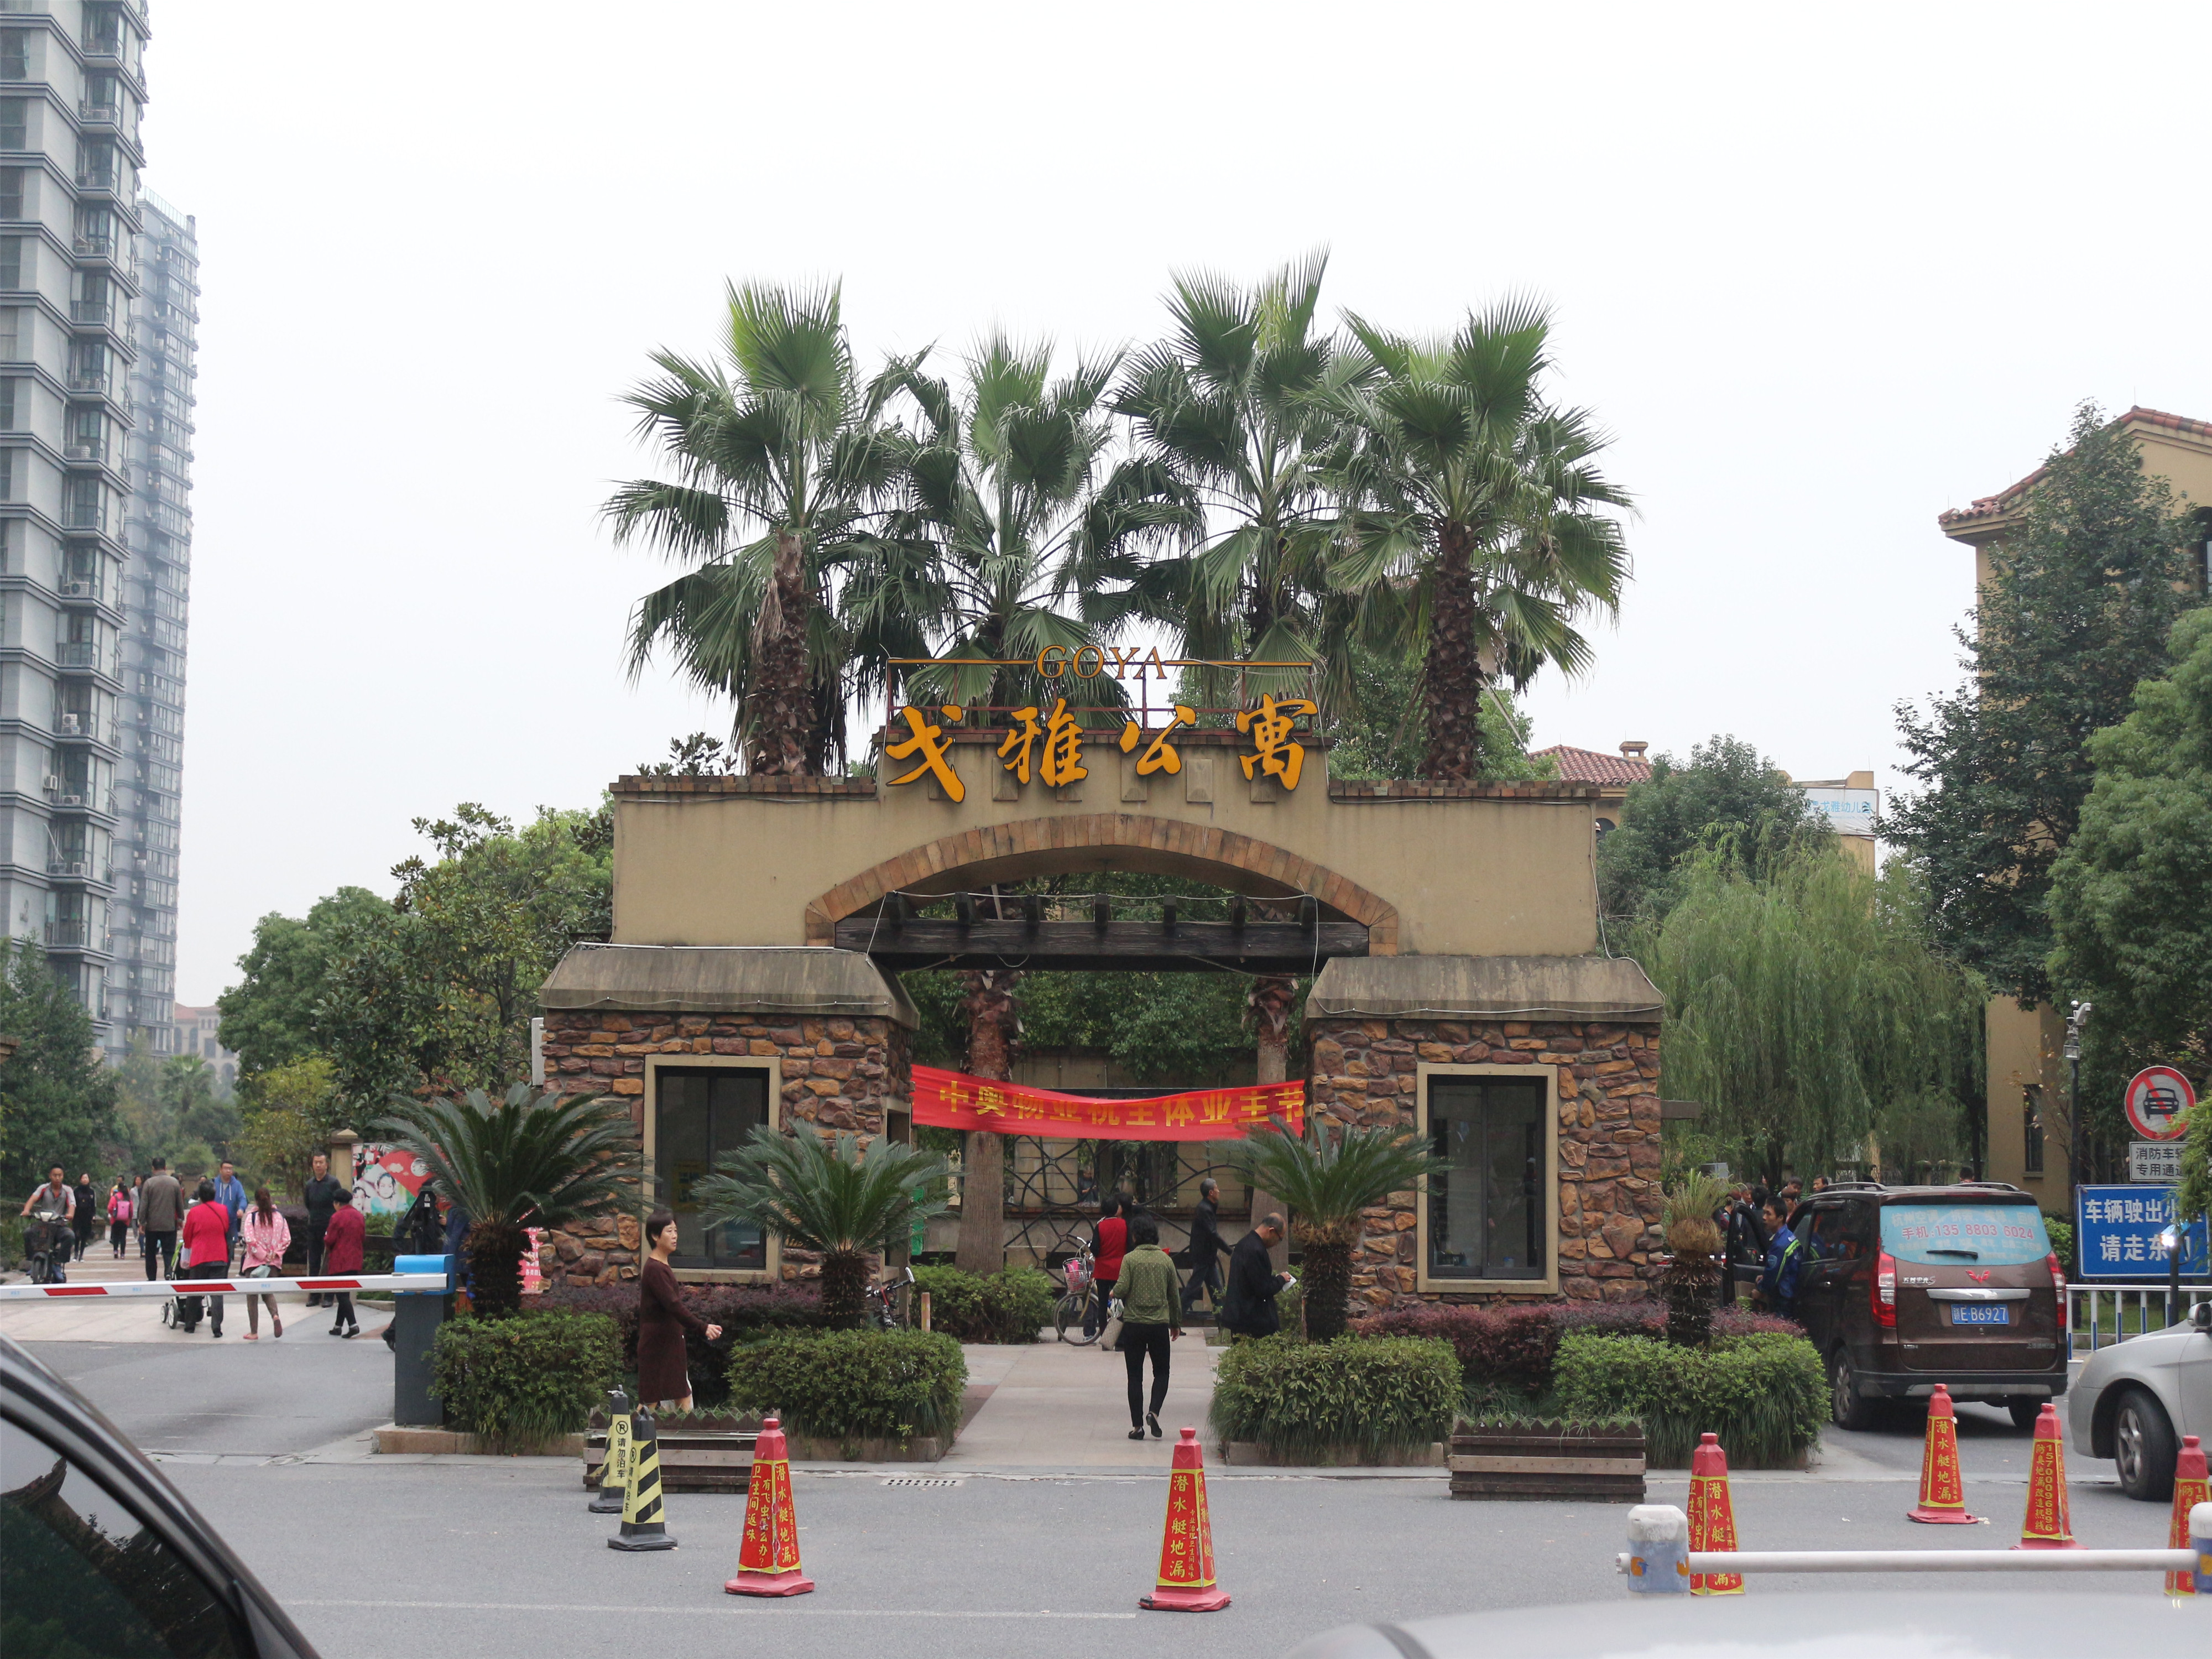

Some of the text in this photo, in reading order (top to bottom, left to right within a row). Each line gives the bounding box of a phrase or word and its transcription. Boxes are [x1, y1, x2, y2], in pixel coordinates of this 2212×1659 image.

[1037, 645, 1167, 681] GOYA
[885, 693, 1318, 803] 戈雅公寓
[1965, 1224, 1997, 1237] 8803
[2004, 1225, 2034, 1240] 6024
[2085, 1199, 2203, 1224] 车辆驶出小
[617, 1438, 626, 1479] 请勿泊车
[1936, 1421, 1951, 1501] 潜水艇地漏
[2036, 1444, 2045, 1530] 防臭地漏改造热线
[2045, 1444, 2053, 1531] 15700096896
[747, 1465, 761, 1542] 卫生间返味
[776, 1465, 791, 1563] 潜水艇地漏
[1169, 1475, 1188, 1578] 潜水艇地漏
[1708, 1482, 1729, 1586] 潜水艇漏
